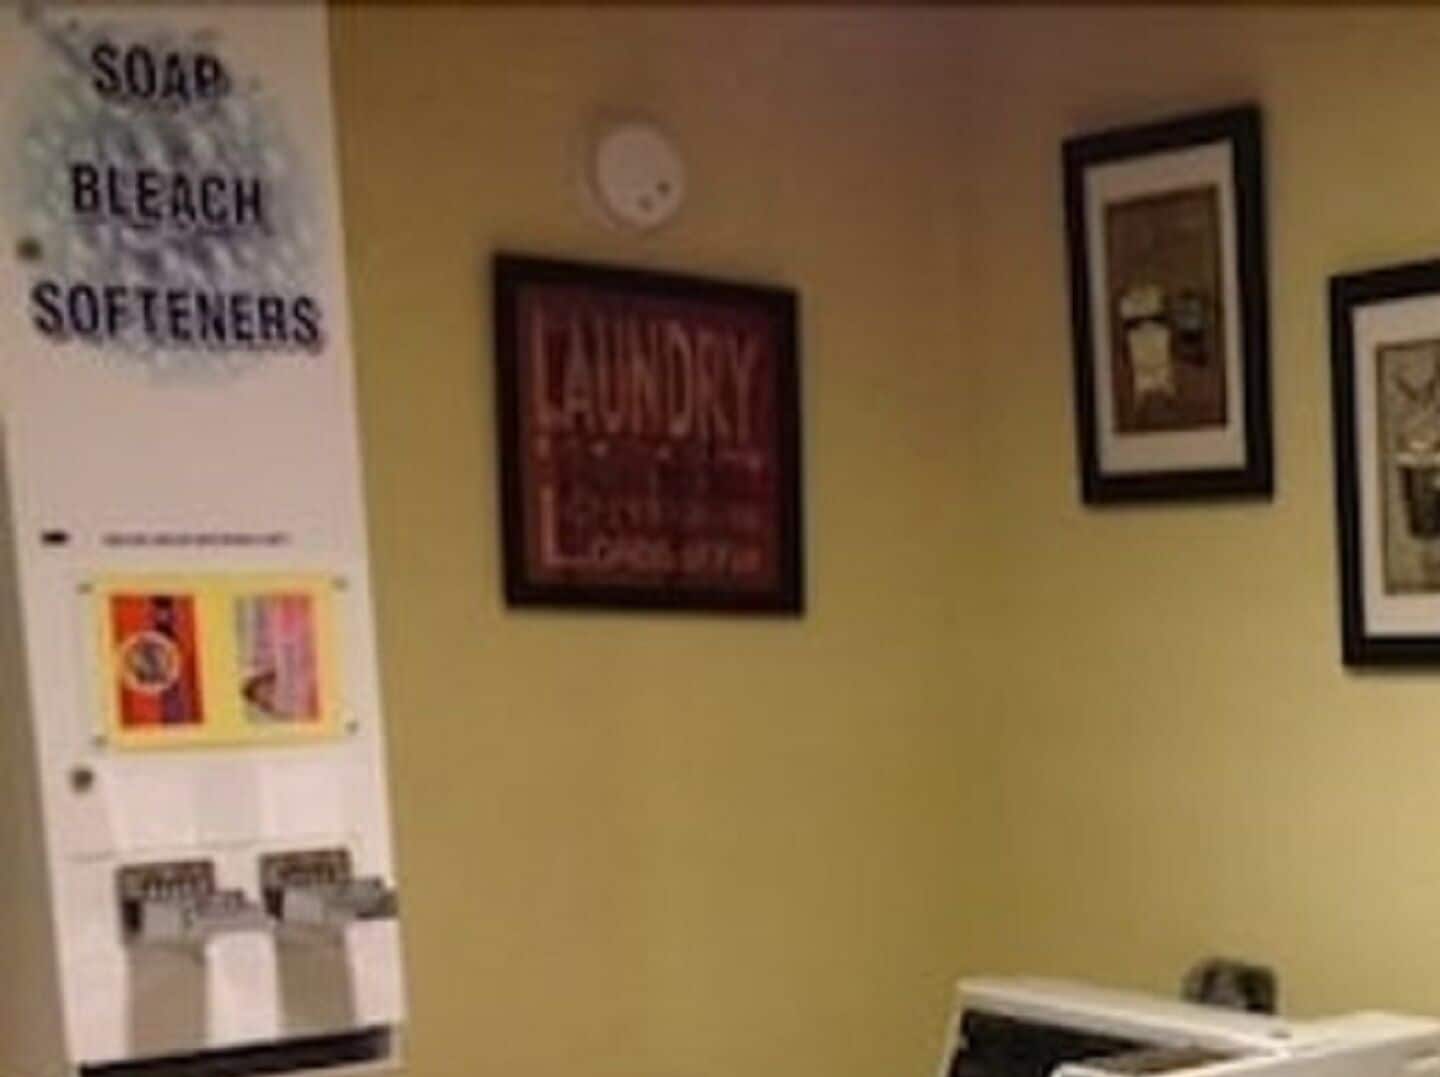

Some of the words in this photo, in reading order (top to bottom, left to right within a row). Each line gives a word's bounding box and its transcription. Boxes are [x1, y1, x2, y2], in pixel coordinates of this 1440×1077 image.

[91, 42, 229, 100] SOAP
[70, 161, 266, 227] BLEACH
[31, 280, 324, 348] SOFTENERS
[531, 302, 764, 445] LAUNDRY
